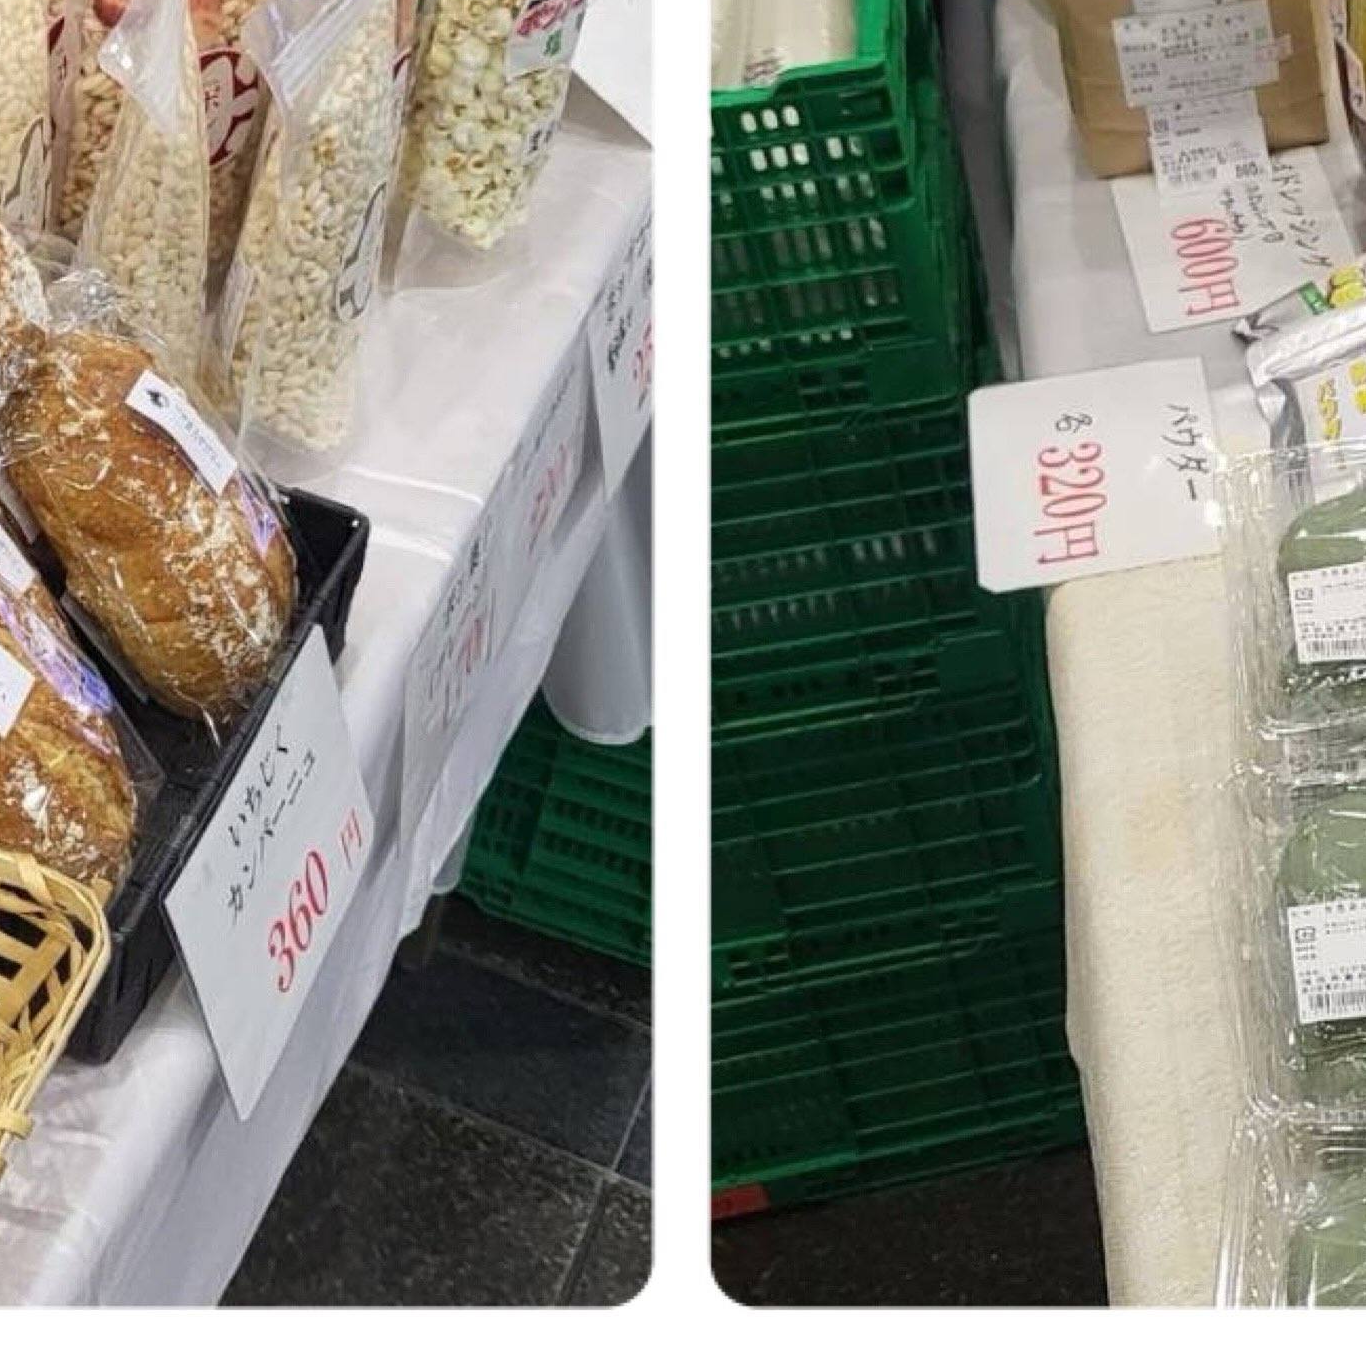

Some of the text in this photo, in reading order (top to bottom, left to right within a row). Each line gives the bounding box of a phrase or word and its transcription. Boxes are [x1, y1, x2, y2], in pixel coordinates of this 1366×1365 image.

[1170, 217, 1241, 317] 600円
[1161, 403, 1209, 502] パウダー
[228, 722, 292, 848] いちじく
